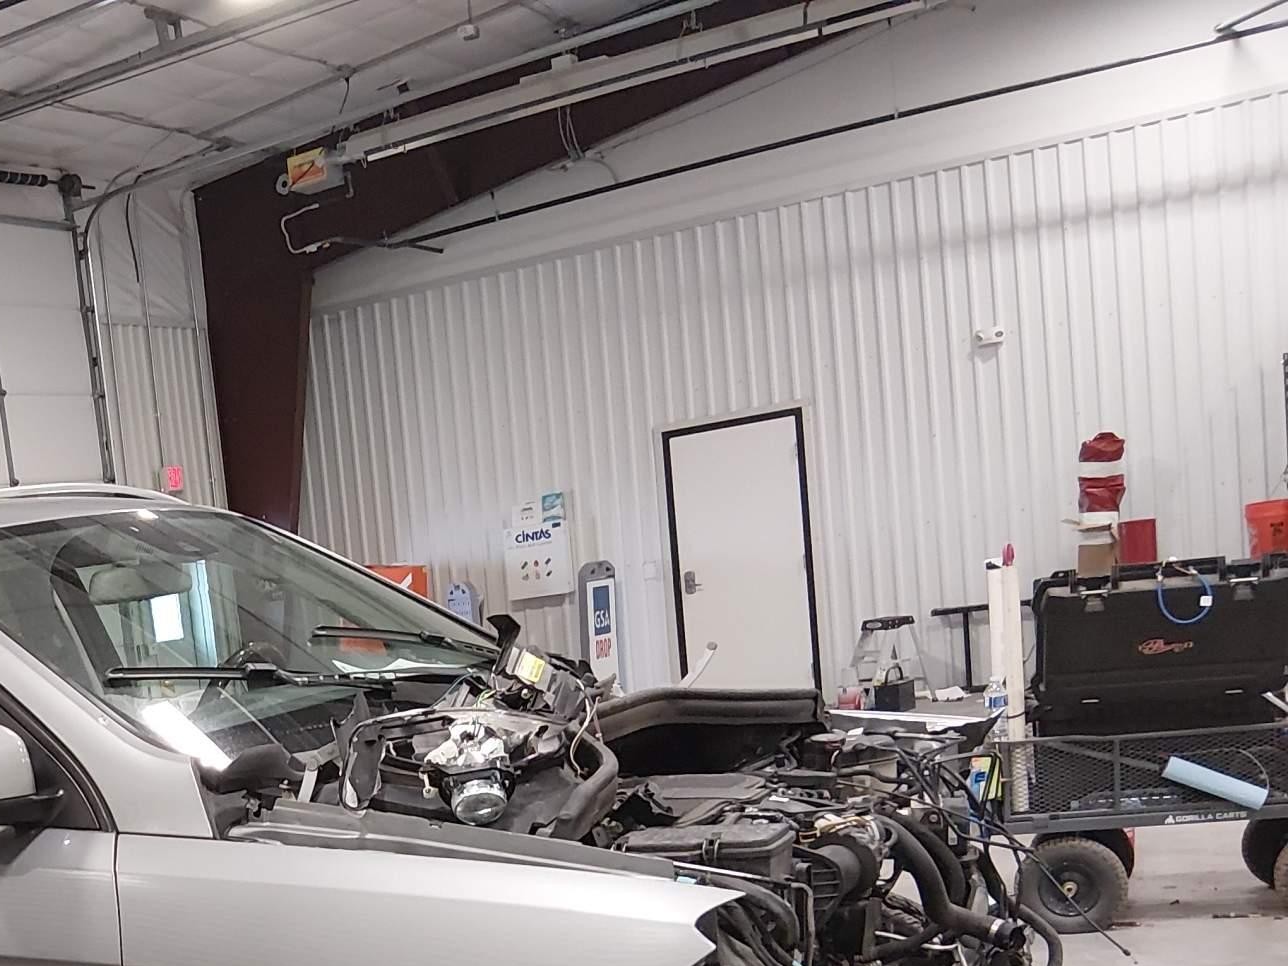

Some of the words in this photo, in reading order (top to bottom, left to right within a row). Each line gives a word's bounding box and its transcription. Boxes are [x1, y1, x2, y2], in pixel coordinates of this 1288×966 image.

[515, 528, 552, 544] CINTAS
[594, 609, 610, 628] GSA
[595, 638, 611, 659] DROP
[1175, 813, 1214, 822] GORILLA
[1215, 811, 1248, 820] CARTS
